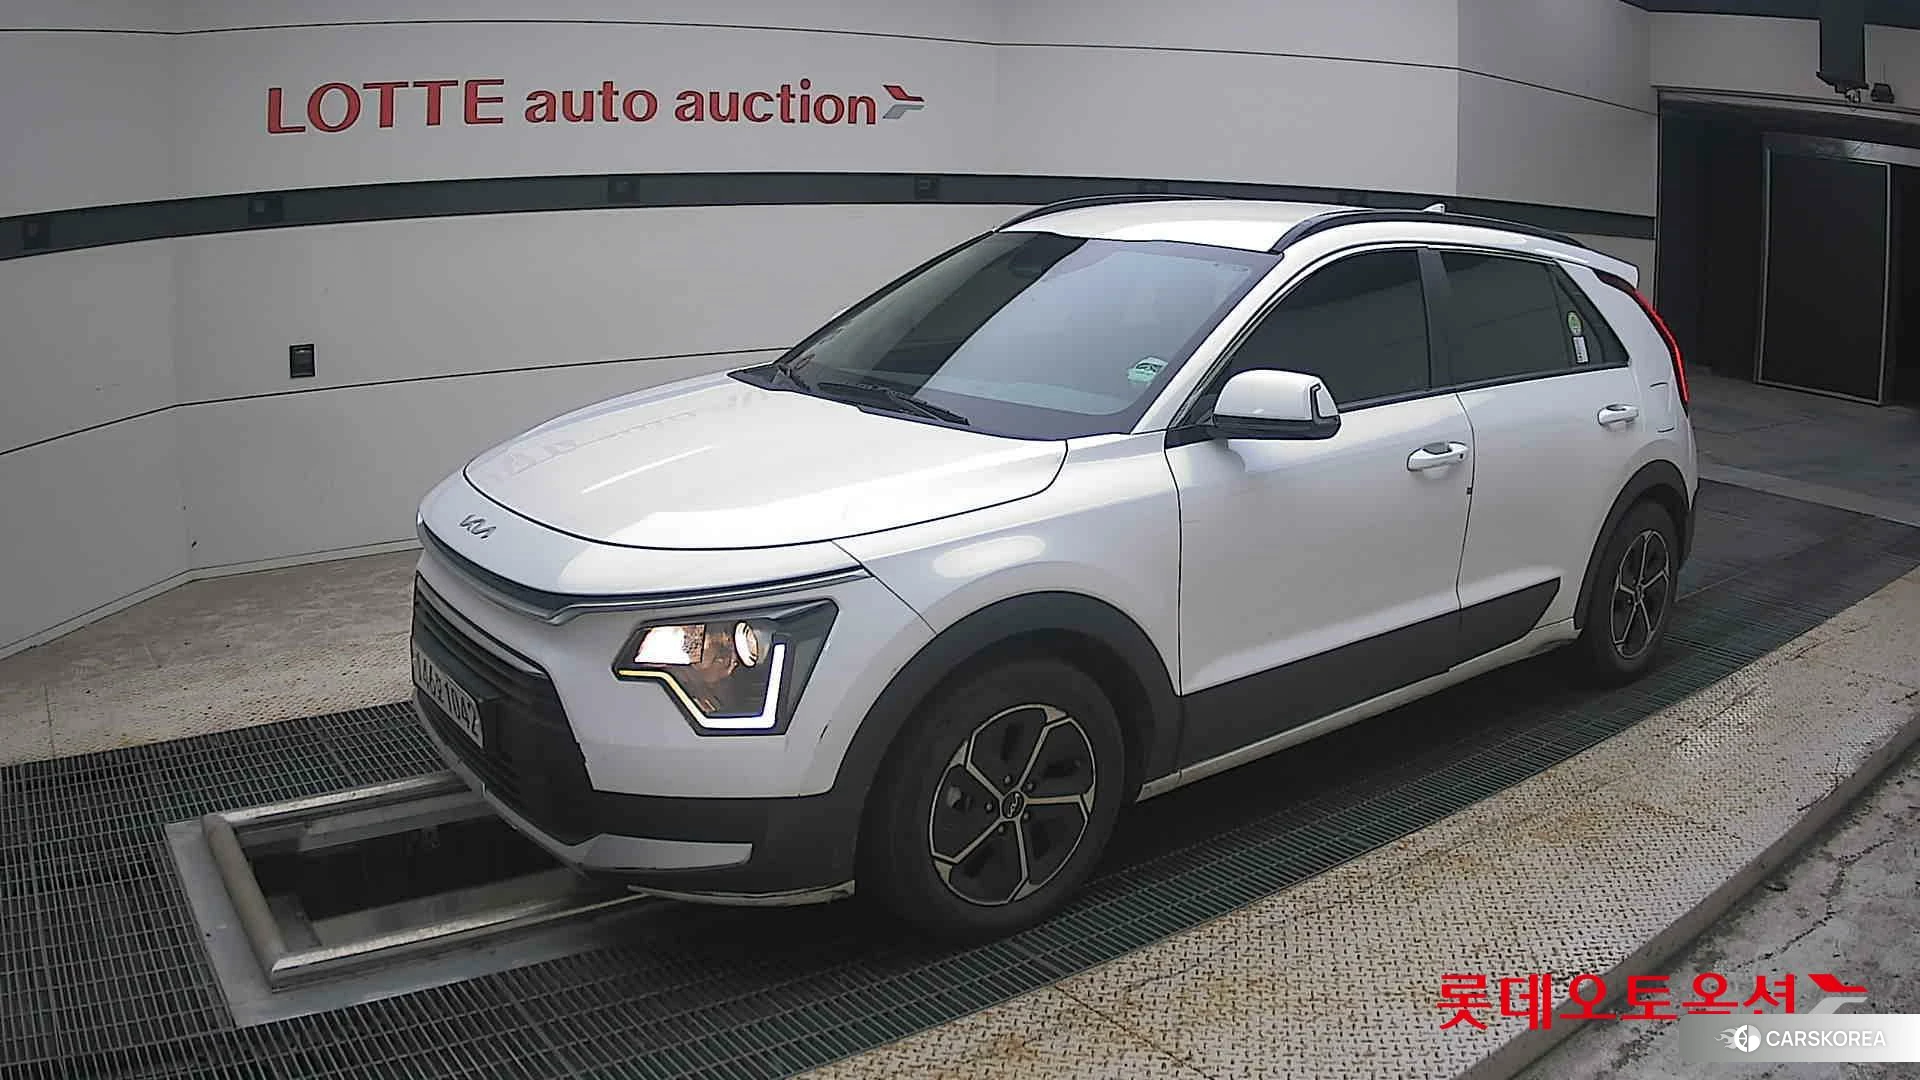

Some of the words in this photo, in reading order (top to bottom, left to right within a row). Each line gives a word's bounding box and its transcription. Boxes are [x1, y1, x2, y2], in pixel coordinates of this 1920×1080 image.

[267, 79, 505, 134] LOTTE
[524, 80, 659, 123] auto
[674, 78, 877, 125] auction
[444, 681, 480, 738] 1042
